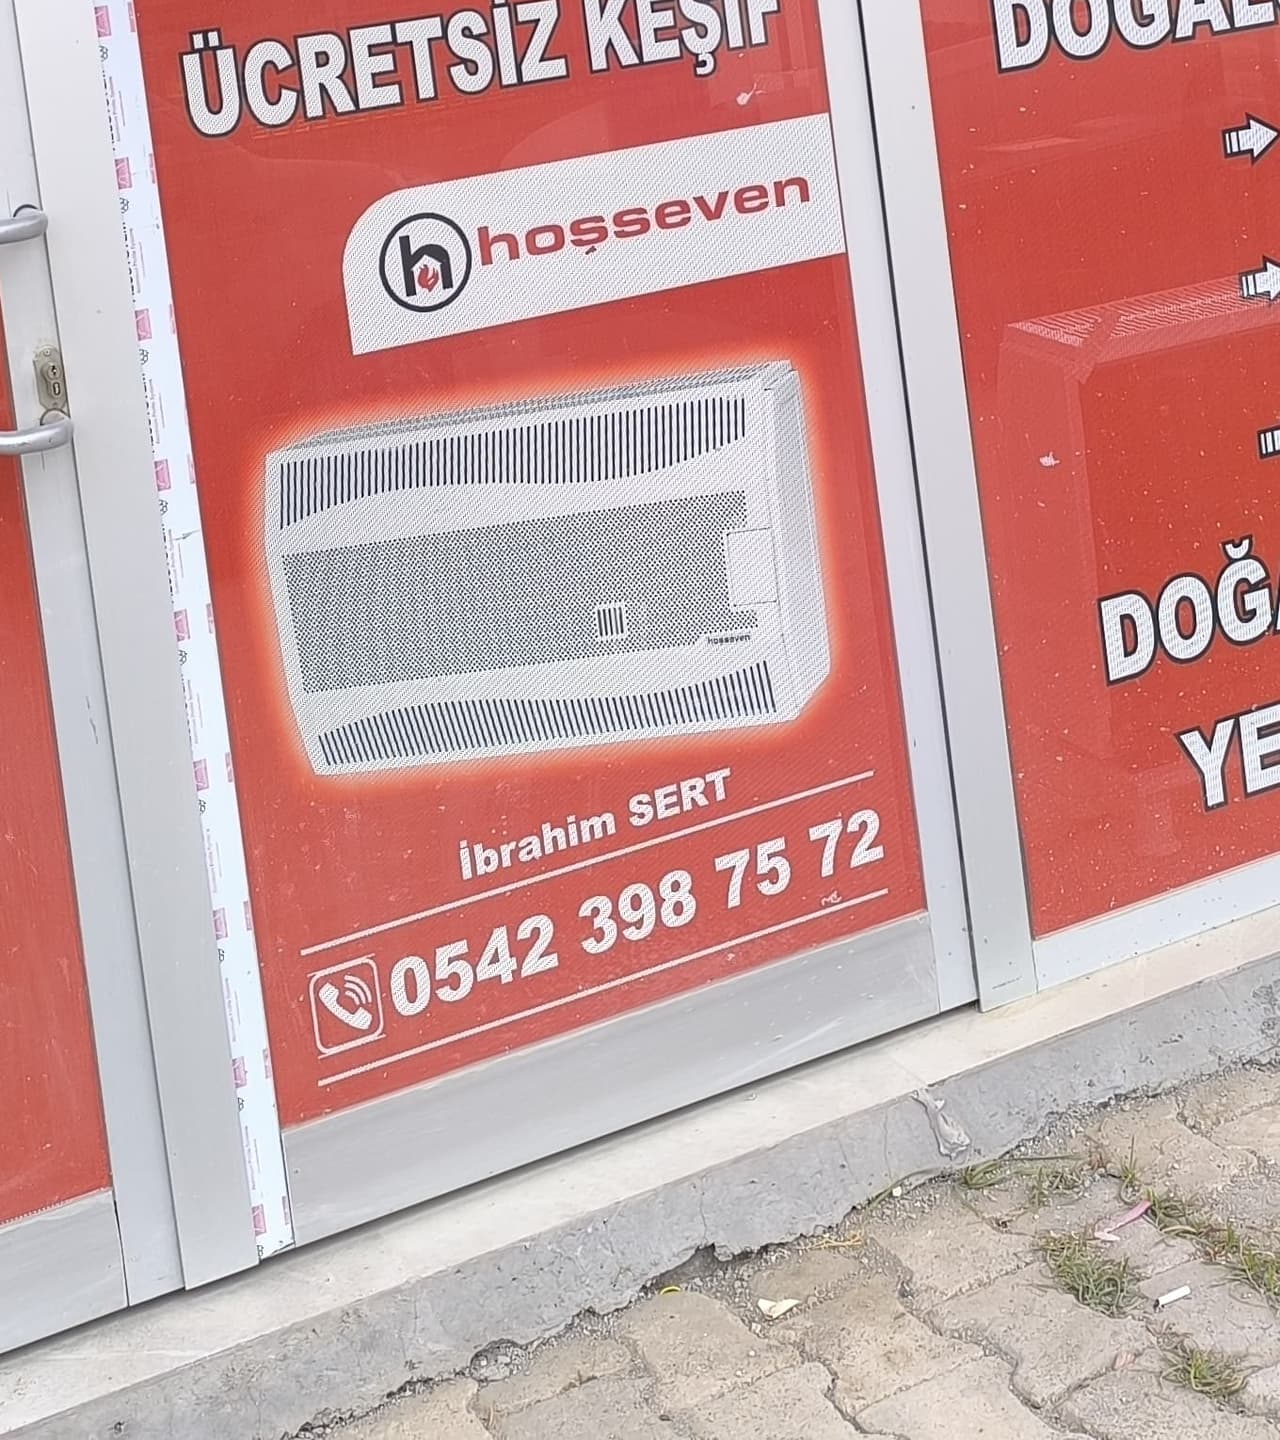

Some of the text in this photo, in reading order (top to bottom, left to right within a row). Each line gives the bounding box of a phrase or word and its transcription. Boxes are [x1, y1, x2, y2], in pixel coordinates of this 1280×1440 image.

[458, 767, 732, 880] İbrahim SERT
[390, 808, 886, 1017] 0542 398 75 72
